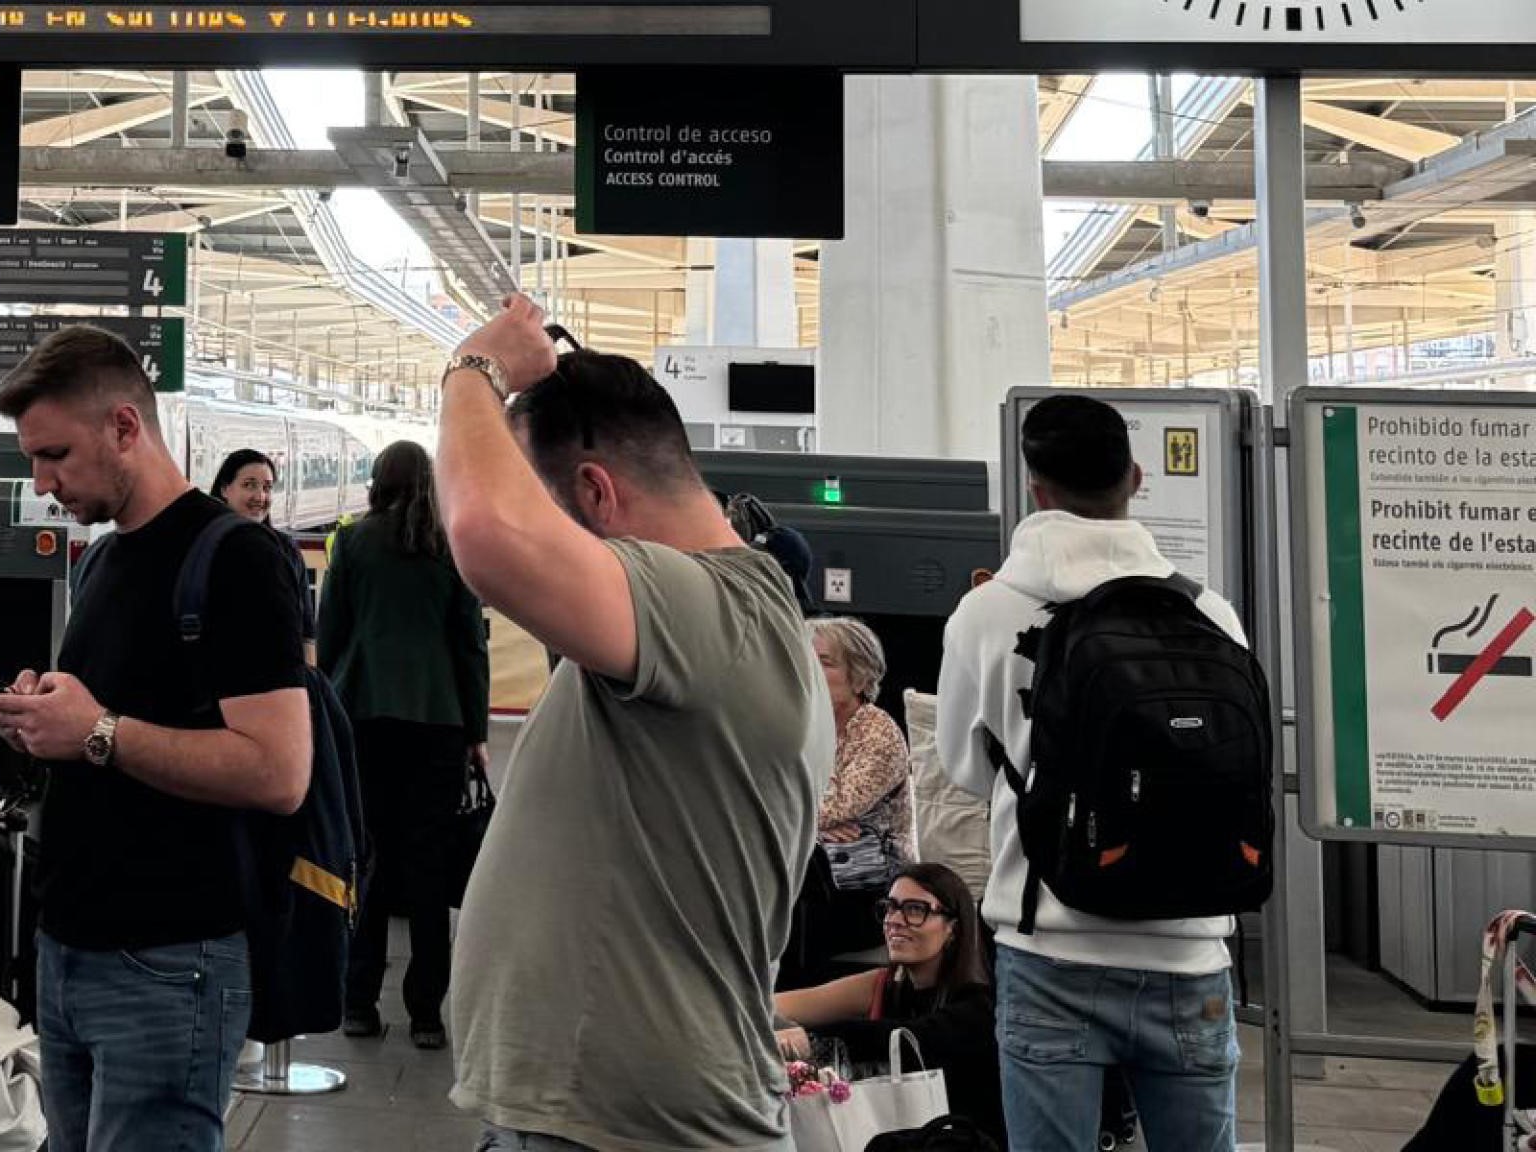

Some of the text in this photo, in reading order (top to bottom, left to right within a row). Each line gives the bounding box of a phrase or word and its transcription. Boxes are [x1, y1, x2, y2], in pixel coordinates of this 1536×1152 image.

[604, 124, 773, 143] Control de acceso
[604, 148, 733, 166] Control d'accés
[606, 172, 721, 187] ACCESS CONTROL
[142, 268, 165, 297] 4
[142, 354, 162, 383] 4
[664, 354, 682, 379] 4
[1368, 415, 1531, 438] Prohibido fumar
[1368, 445, 1437, 466] recinto
[1443, 447, 1468, 466] de
[1475, 447, 1493, 467] la
[1371, 499, 1453, 520] Prohibit
[1459, 501, 1521, 521] fumar
[1372, 529, 1441, 550] recinte
[1448, 531, 1474, 552] de
